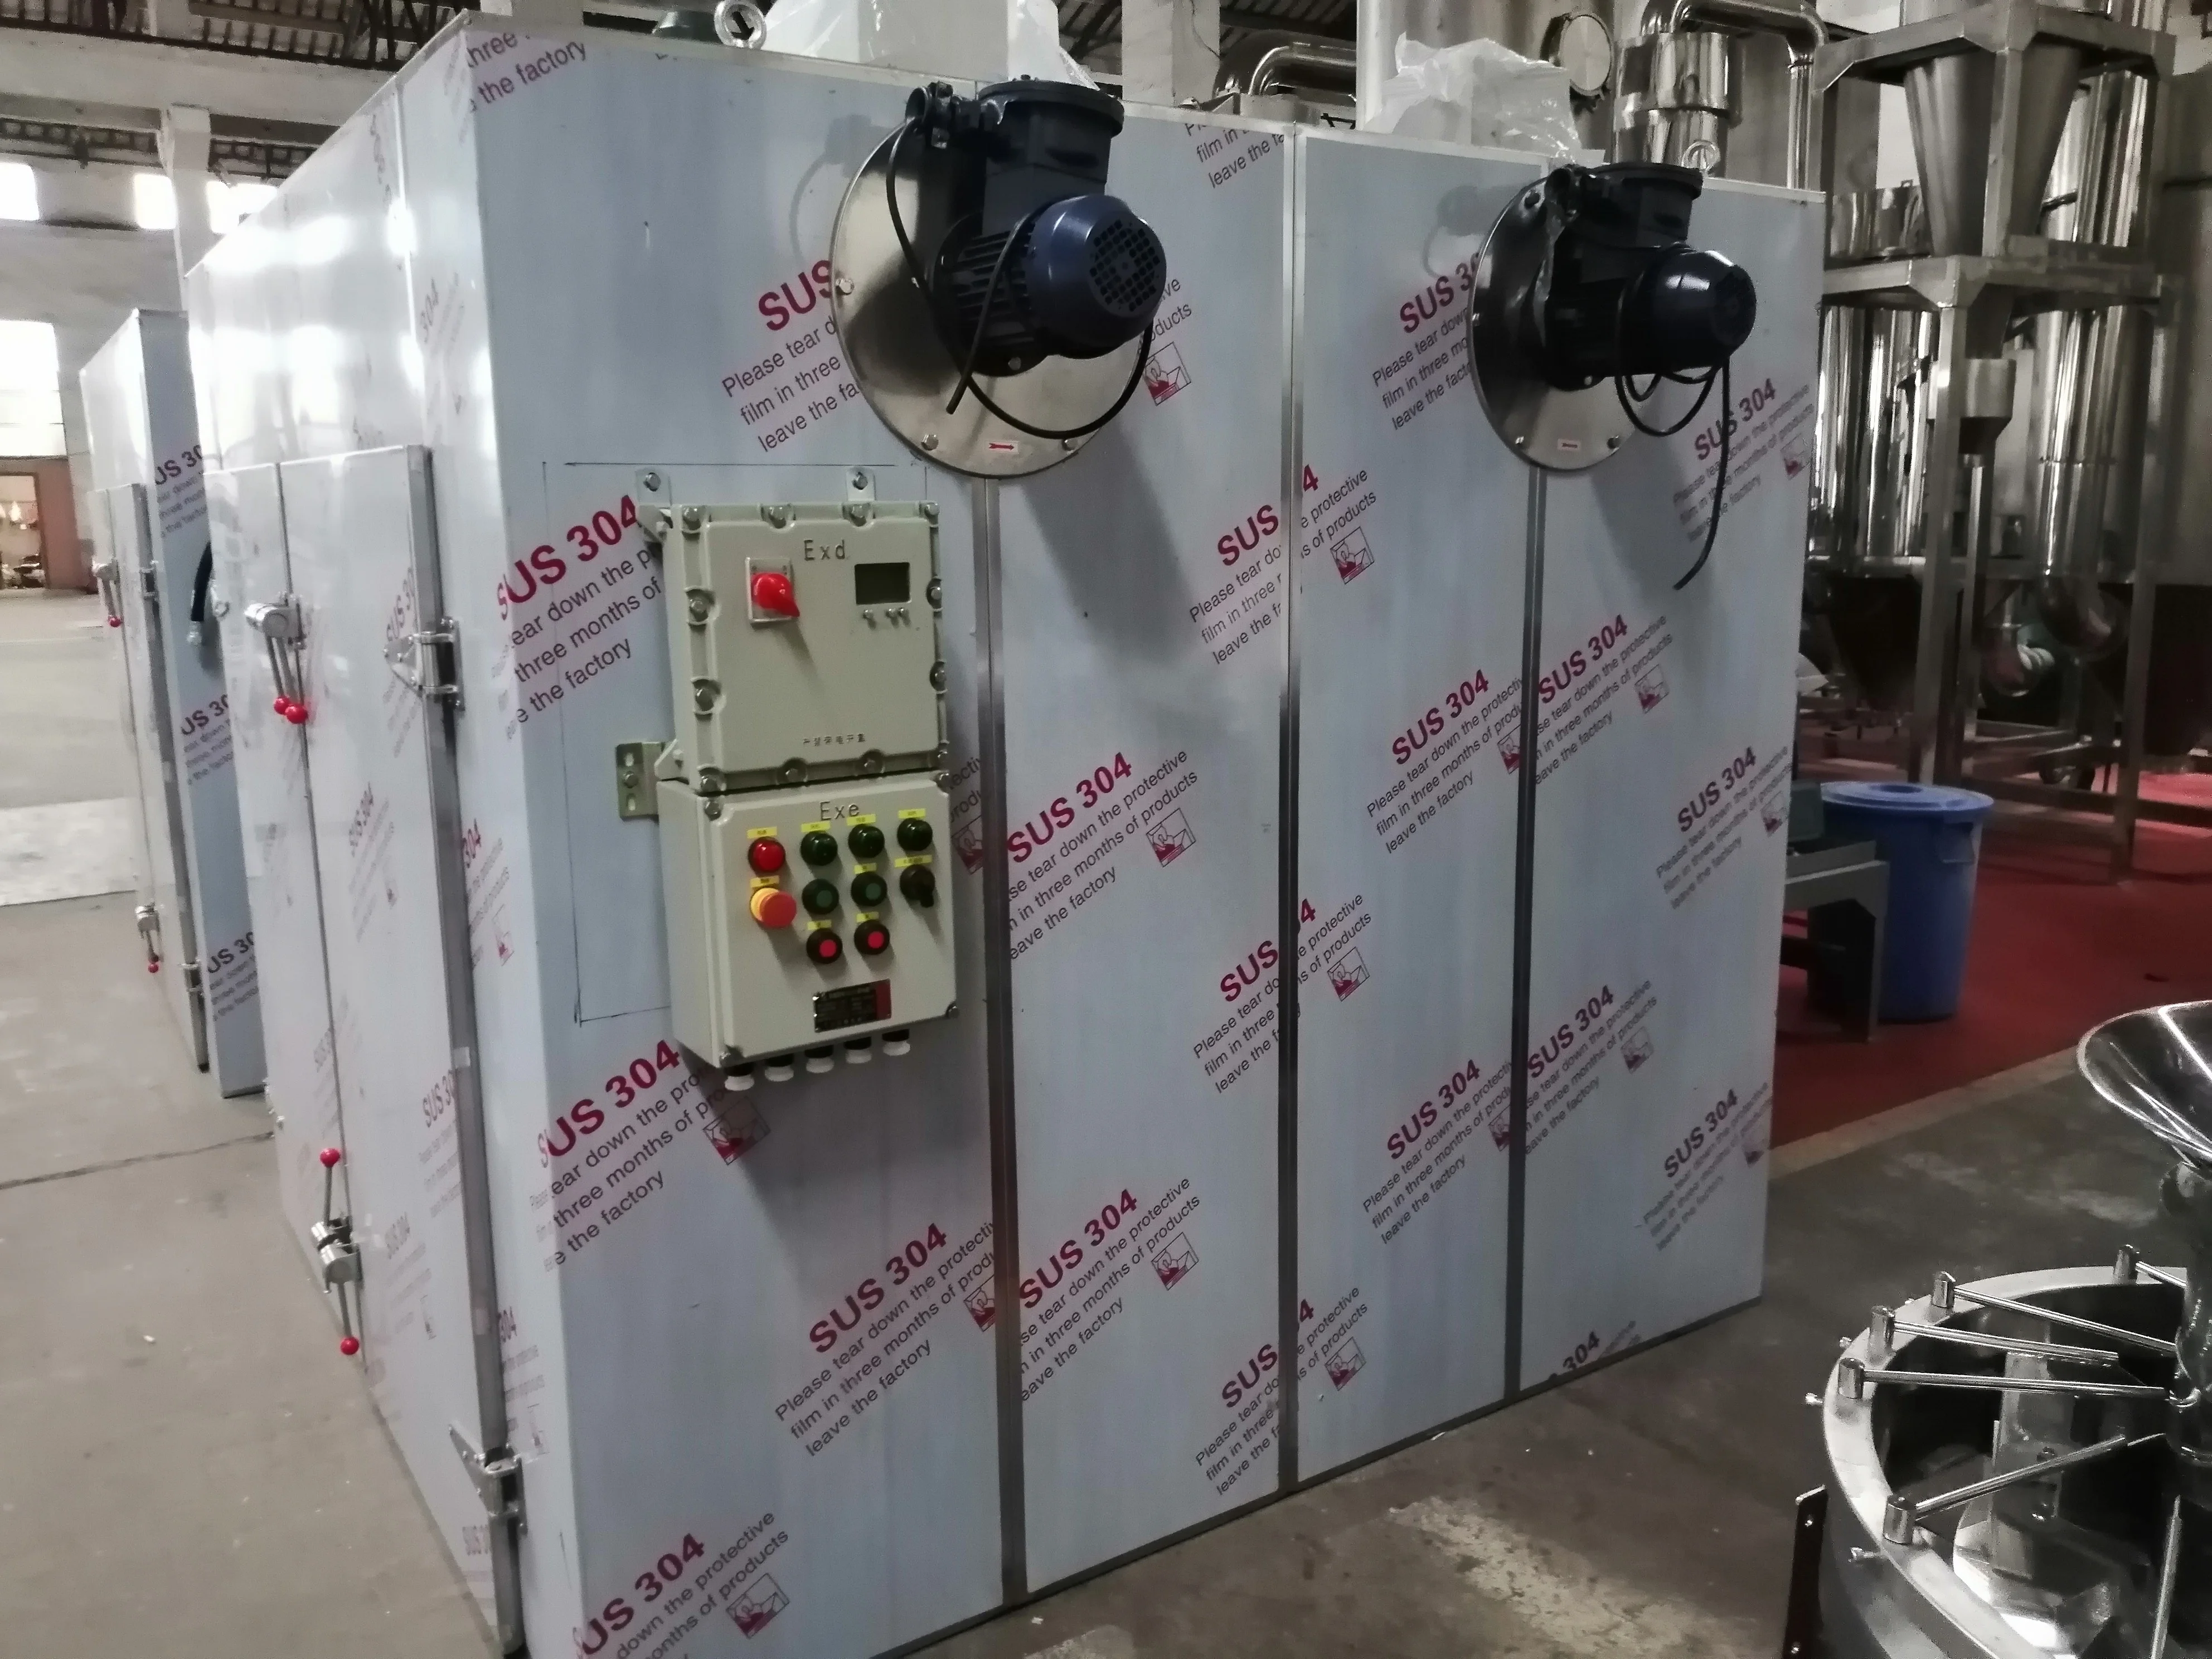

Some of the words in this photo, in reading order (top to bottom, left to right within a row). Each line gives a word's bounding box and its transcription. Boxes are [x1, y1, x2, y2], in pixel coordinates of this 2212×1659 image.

[477, 77, 515, 104] the
[515, 42, 586, 85] factory
[1196, 139, 1223, 162] film
[1209, 157, 1246, 188] leave
[1248, 139, 1270, 162] the
[420, 277, 439, 343] 304
[758, 260, 831, 332] SUS
[1400, 275, 1454, 333] SUS
[722, 353, 784, 397] Please
[786, 329, 820, 358] tear
[741, 398, 775, 425] film
[777, 386, 794, 403] in
[795, 357, 840, 390] three
[1372, 352, 1413, 387] Please
[1418, 331, 1437, 353] tear
[1382, 387, 1404, 408] film
[1406, 376, 1418, 391] in
[1419, 353, 1449, 381] three
[758, 416, 807, 452] leave
[808, 396, 837, 420] the
[1392, 400, 1424, 430] leave
[1425, 385, 1444, 404] the
[1739, 378, 1776, 422] 304
[155, 459, 182, 485] US
[1311, 470, 1367, 523] protective
[566, 494, 636, 562] 304
[804, 540, 846, 561] Exd
[1217, 505, 1279, 566] SUS
[1312, 529, 1324, 548] of
[1326, 492, 1376, 540] products
[547, 582, 601, 622] down
[600, 560, 634, 586] the
[1190, 584, 1235, 622] Please
[1236, 561, 1261, 586] tear
[1202, 621, 1226, 643] film
[1228, 609, 1240, 623] in
[1242, 582, 1275, 612] three
[515, 643, 567, 683] three
[569, 595, 641, 648] months
[642, 576, 662, 600] of
[1212, 632, 1248, 664] leave
[1250, 614, 1271, 634] the
[1541, 650, 1587, 704] SUS
[1588, 614, 1627, 661] 304
[529, 685, 564, 712] the
[565, 638, 631, 689] factory
[181, 710, 210, 736] US
[1392, 707, 1444, 765] SUS
[1445, 669, 1489, 719] 304
[1367, 780, 1406, 817] Please
[1407, 758, 1429, 782] tear
[1432, 732, 1460, 761] down
[1461, 716, 1479, 735] the
[1376, 814, 1398, 836] film
[1399, 803, 1410, 816] in
[1411, 777, 1439, 805] three
[1442, 740, 1480, 778] months
[1482, 726, 1492, 743] of
[1677, 781, 1720, 833] SUS
[1721, 746, 1756, 790] 304
[820, 801, 860, 821] Exe
[1007, 797, 1075, 862] SUS
[1076, 752, 1132, 808] 304
[1029, 855, 1056, 882] tear
[1060, 824, 1097, 857] down
[1098, 804, 1121, 826] the
[1123, 751, 1187, 810] protective
[1386, 823, 1416, 853] leave
[1418, 806, 1436, 825] the
[1437, 772, 1472, 808] factory
[1020, 905, 1034, 920] in
[1035, 874, 1071, 907] three
[1074, 832, 1124, 877] months
[1126, 815, 1139, 834] of
[1141, 772, 1197, 825] products
[1045, 908, 1068, 929] the
[1069, 867, 1115, 909] factory
[1308, 895, 1362, 950] protective
[207, 948, 235, 974] US
[1220, 940, 1278, 1002] SUS
[1310, 955, 1321, 973] of
[1323, 914, 1371, 964] products
[1194, 1017, 1236, 1059] Please
[1238, 992, 1262, 1018] tear
[1205, 1052, 1228, 1076] film
[1230, 1040, 1242, 1054] in
[1243, 1010, 1274, 1041] three
[1528, 1024, 1574, 1078] SUS
[1575, 985, 1614, 1031] 304
[605, 1040, 680, 1108] 304
[1215, 1060, 1249, 1093] leave
[1251, 1040, 1270, 1061] the
[586, 1126, 636, 1167] down
[637, 1100, 667, 1126] the
[1387, 1101, 1438, 1160] SUS
[1438, 1059, 1480, 1108] 304
[1663, 1126, 1705, 1178] SUS
[1705, 1088, 1738, 1133] 304
[554, 1186, 603, 1228] three
[606, 1131, 673, 1187] months
[675, 1110, 692, 1132] of
[567, 1225, 599, 1251] the
[601, 1171, 663, 1225] factory
[1020, 1239, 1083, 1308] SUS
[1084, 1189, 1137, 1246] 304
[1031, 1347, 1045, 1362] in
[1045, 1312, 1080, 1347] three
[1083, 1264, 1130, 1312] months
[1132, 1245, 1144, 1264] of
[1146, 1197, 1200, 1253] products
[1039, 1294, 1066, 1324] tear
[1069, 1260, 1104, 1296] down
[1105, 1238, 1127, 1261] the
[1129, 1178, 1190, 1241] protective
[809, 1278, 885, 1353] SUS
[885, 1223, 947, 1286] 304
[1307, 1288, 1359, 1347] protective
[775, 1370, 832, 1421] Please
[833, 1337, 864, 1369] tear
[868, 1300, 909, 1338] down
[910, 1276, 935, 1300] the
[790, 1410, 822, 1438] film
[822, 1394, 840, 1411] in
[840, 1356, 881, 1394] three
[884, 1303, 939, 1356] months
[941, 1284, 955, 1304] of
[1054, 1344, 1077, 1367] the
[1079, 1298, 1122, 1343] factory
[1563, 1331, 1599, 1370] 304
[806, 1415, 850, 1456] leave
[851, 1390, 878, 1414] the
[879, 1340, 930, 1390] factory
[1222, 1343, 1278, 1408] SUS
[634, 1533, 704, 1602] 304
[664, 1589, 692, 1614] the
[695, 1514, 774, 1590] protective
[700, 1594, 716, 1615] of
[719, 1531, 788, 1600] products
